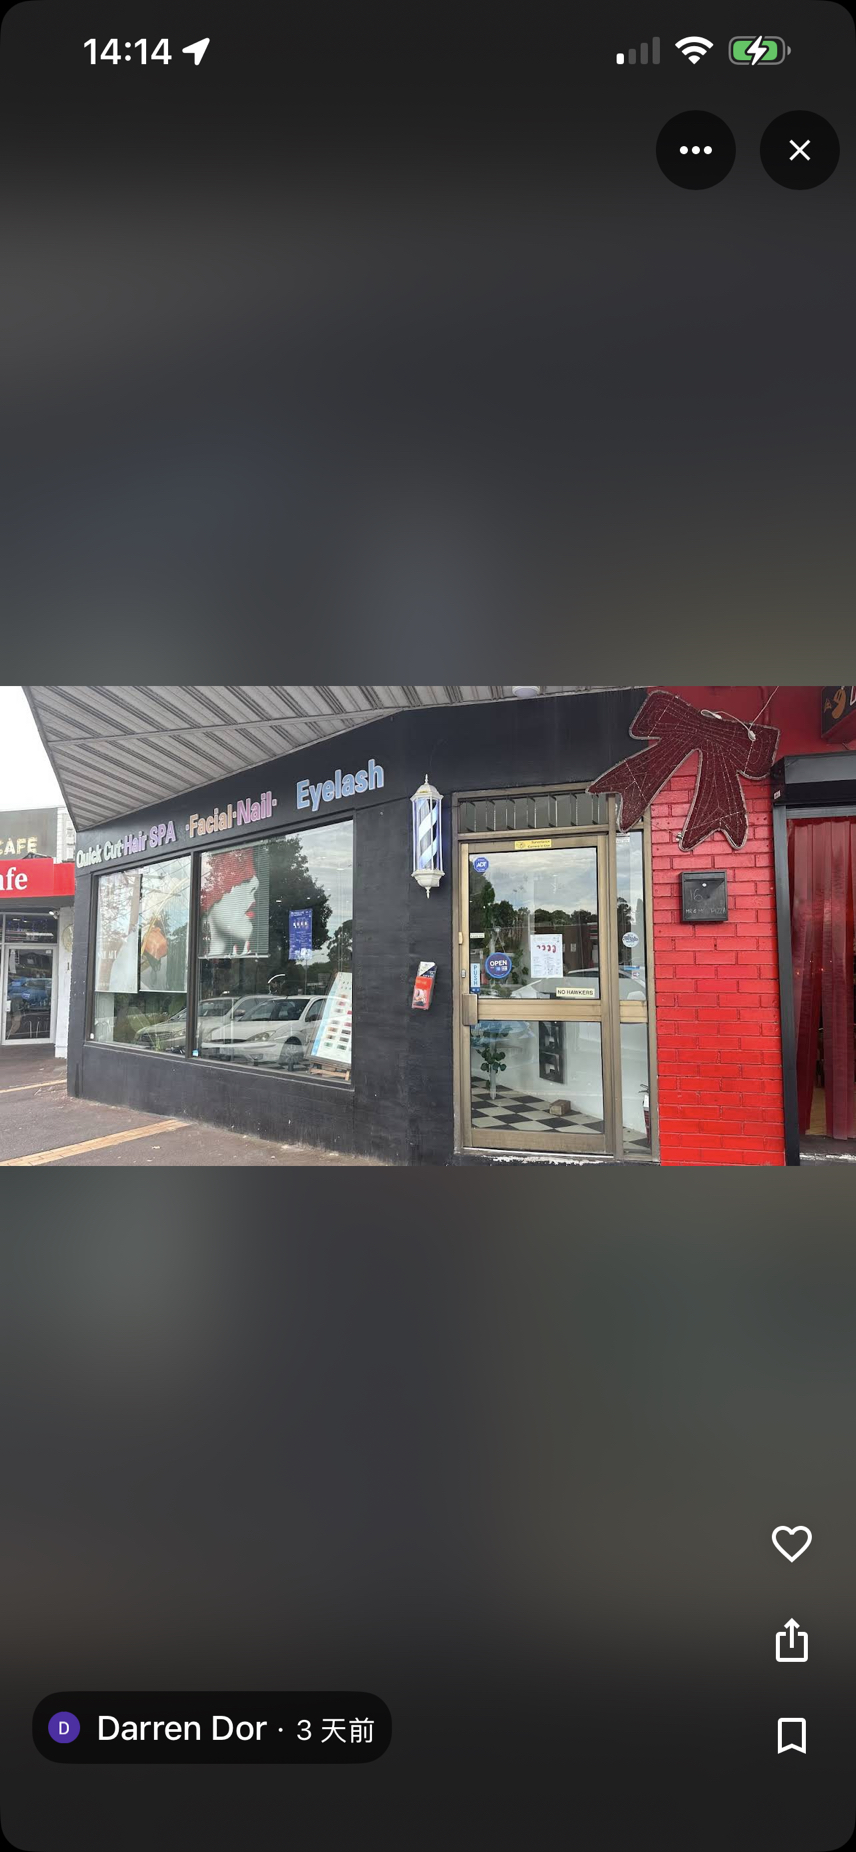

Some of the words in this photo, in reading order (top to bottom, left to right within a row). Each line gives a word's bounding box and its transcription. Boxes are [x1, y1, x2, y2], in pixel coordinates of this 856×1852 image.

[76, 844, 103, 869] Quick
[149, 820, 177, 848] SPA
[296, 758, 385, 812] Eyelash
[689, 888, 703, 902] 16
[489, 959, 508, 967] OPEN
